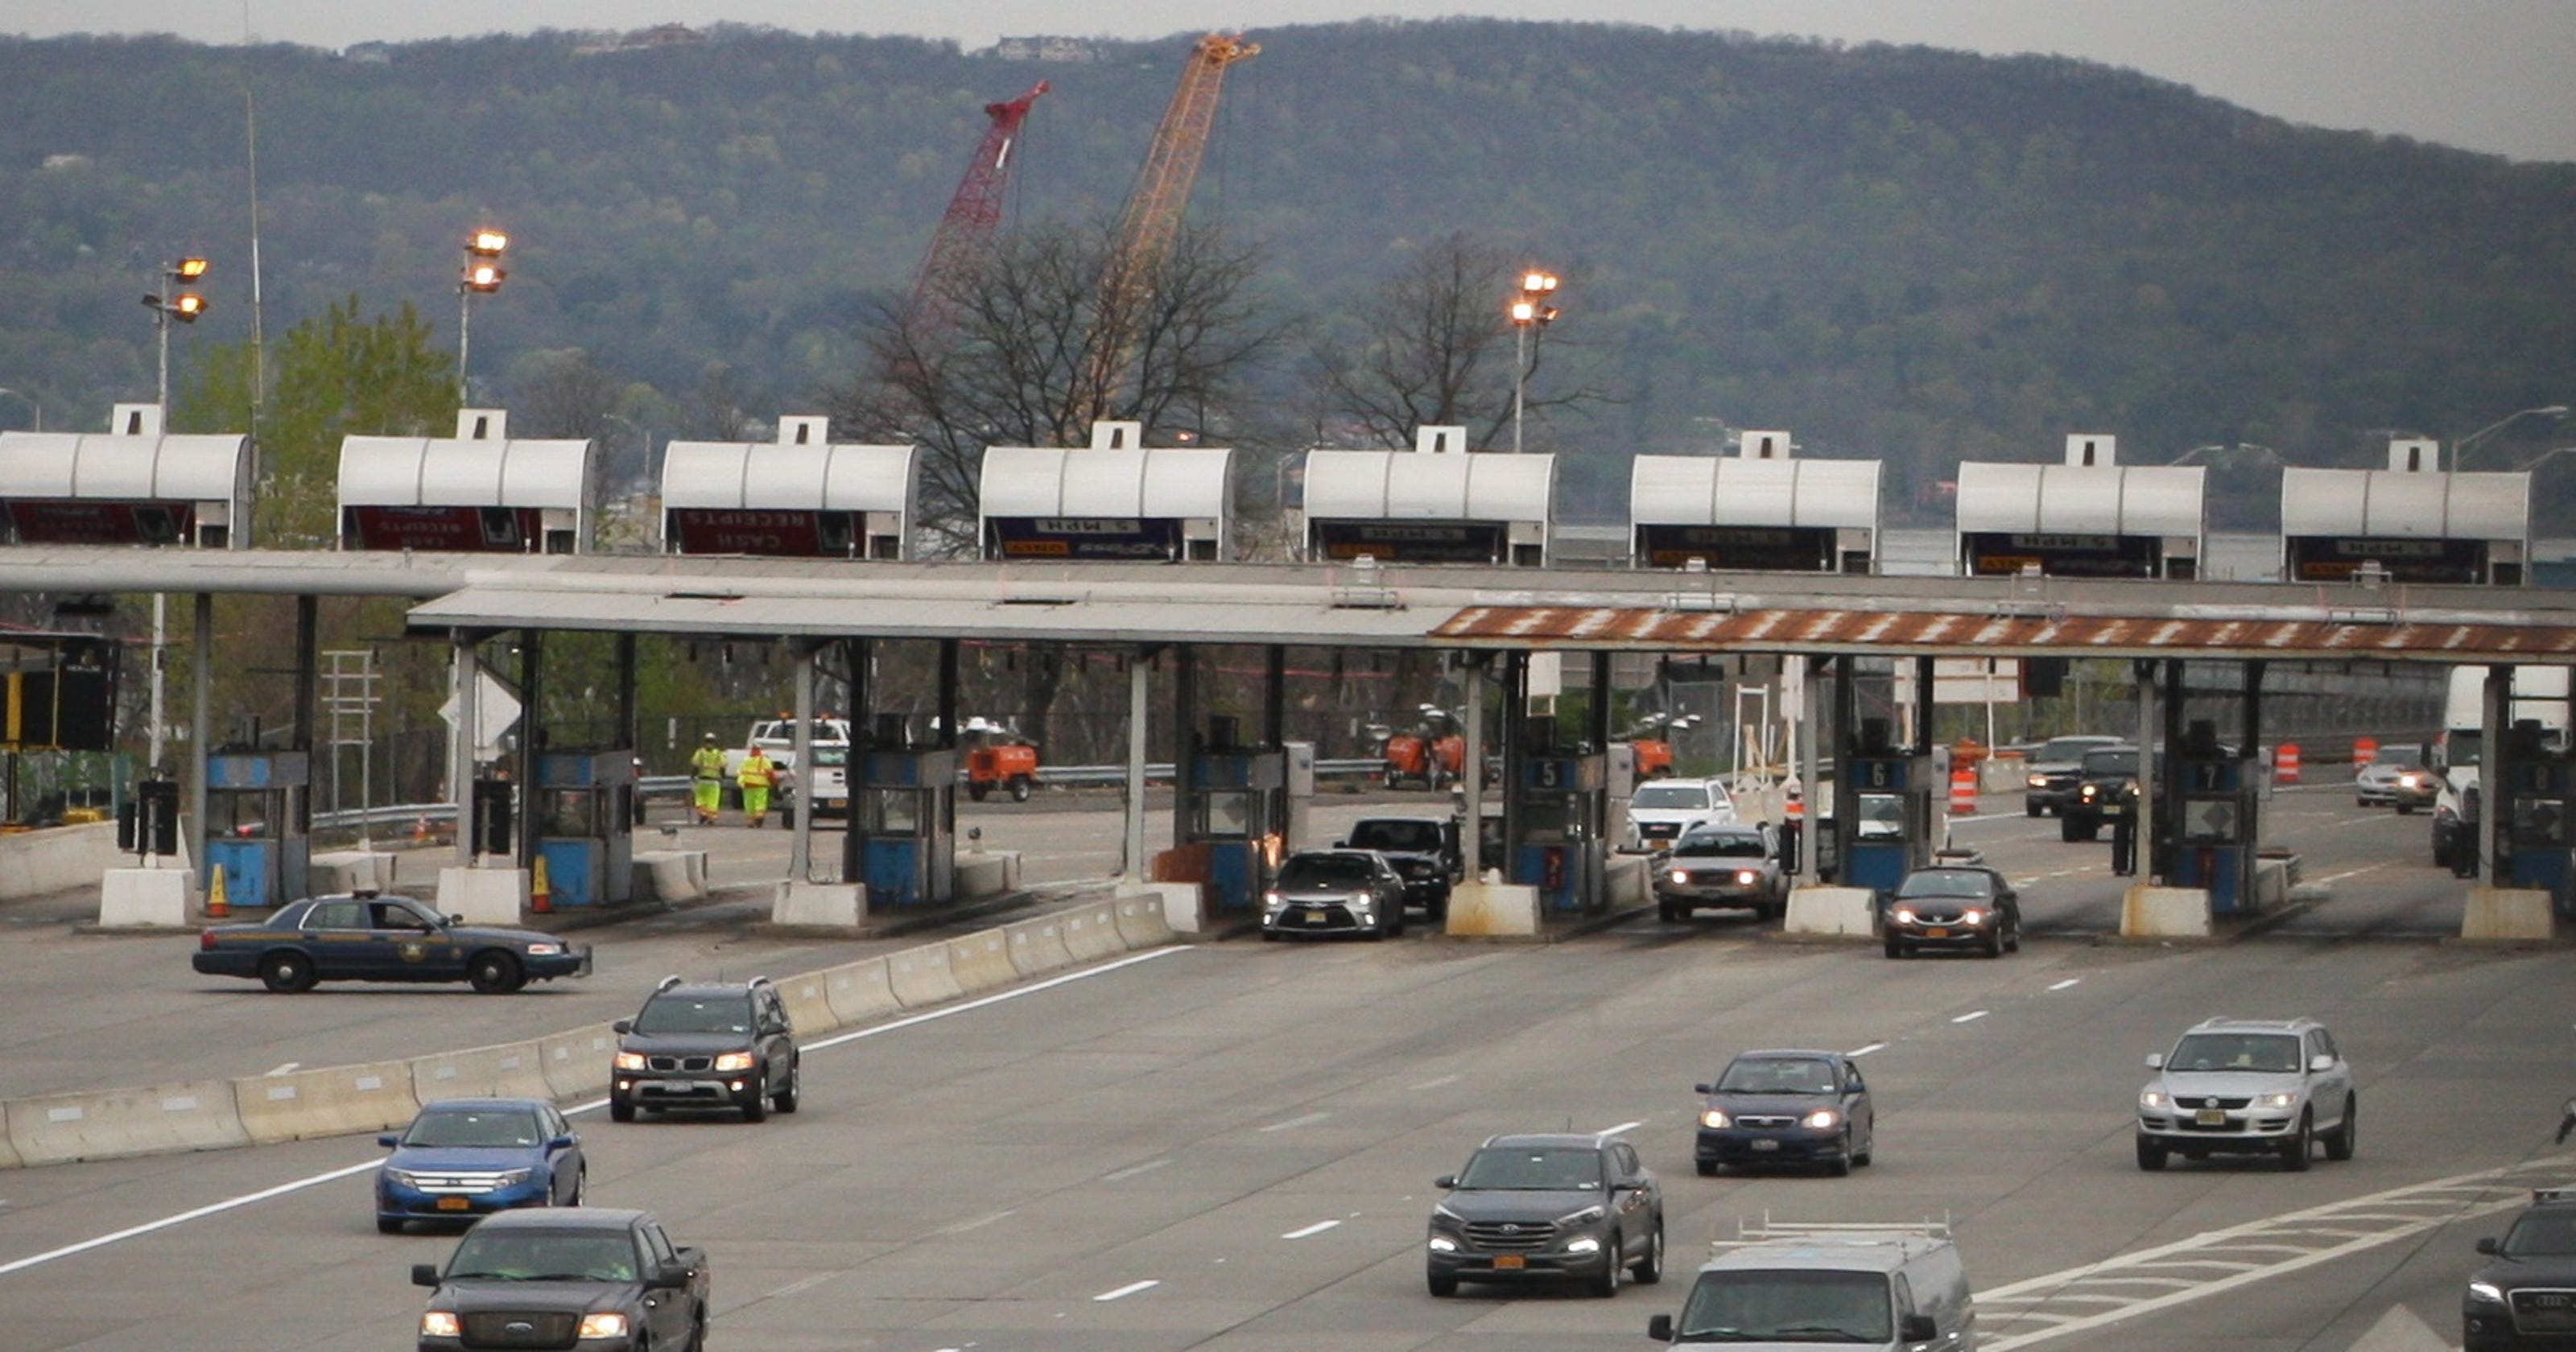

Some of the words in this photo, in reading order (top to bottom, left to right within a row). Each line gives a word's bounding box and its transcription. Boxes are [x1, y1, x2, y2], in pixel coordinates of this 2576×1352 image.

[686, 511, 806, 526] RECEIPTS
[1047, 521, 1101, 531] MPH
[716, 534, 782, 548] CASH
[2023, 536, 2078, 546] MPH
[1542, 762, 1556, 786] 5
[1872, 761, 1885, 786] 6
[2205, 767, 2216, 789] 7
